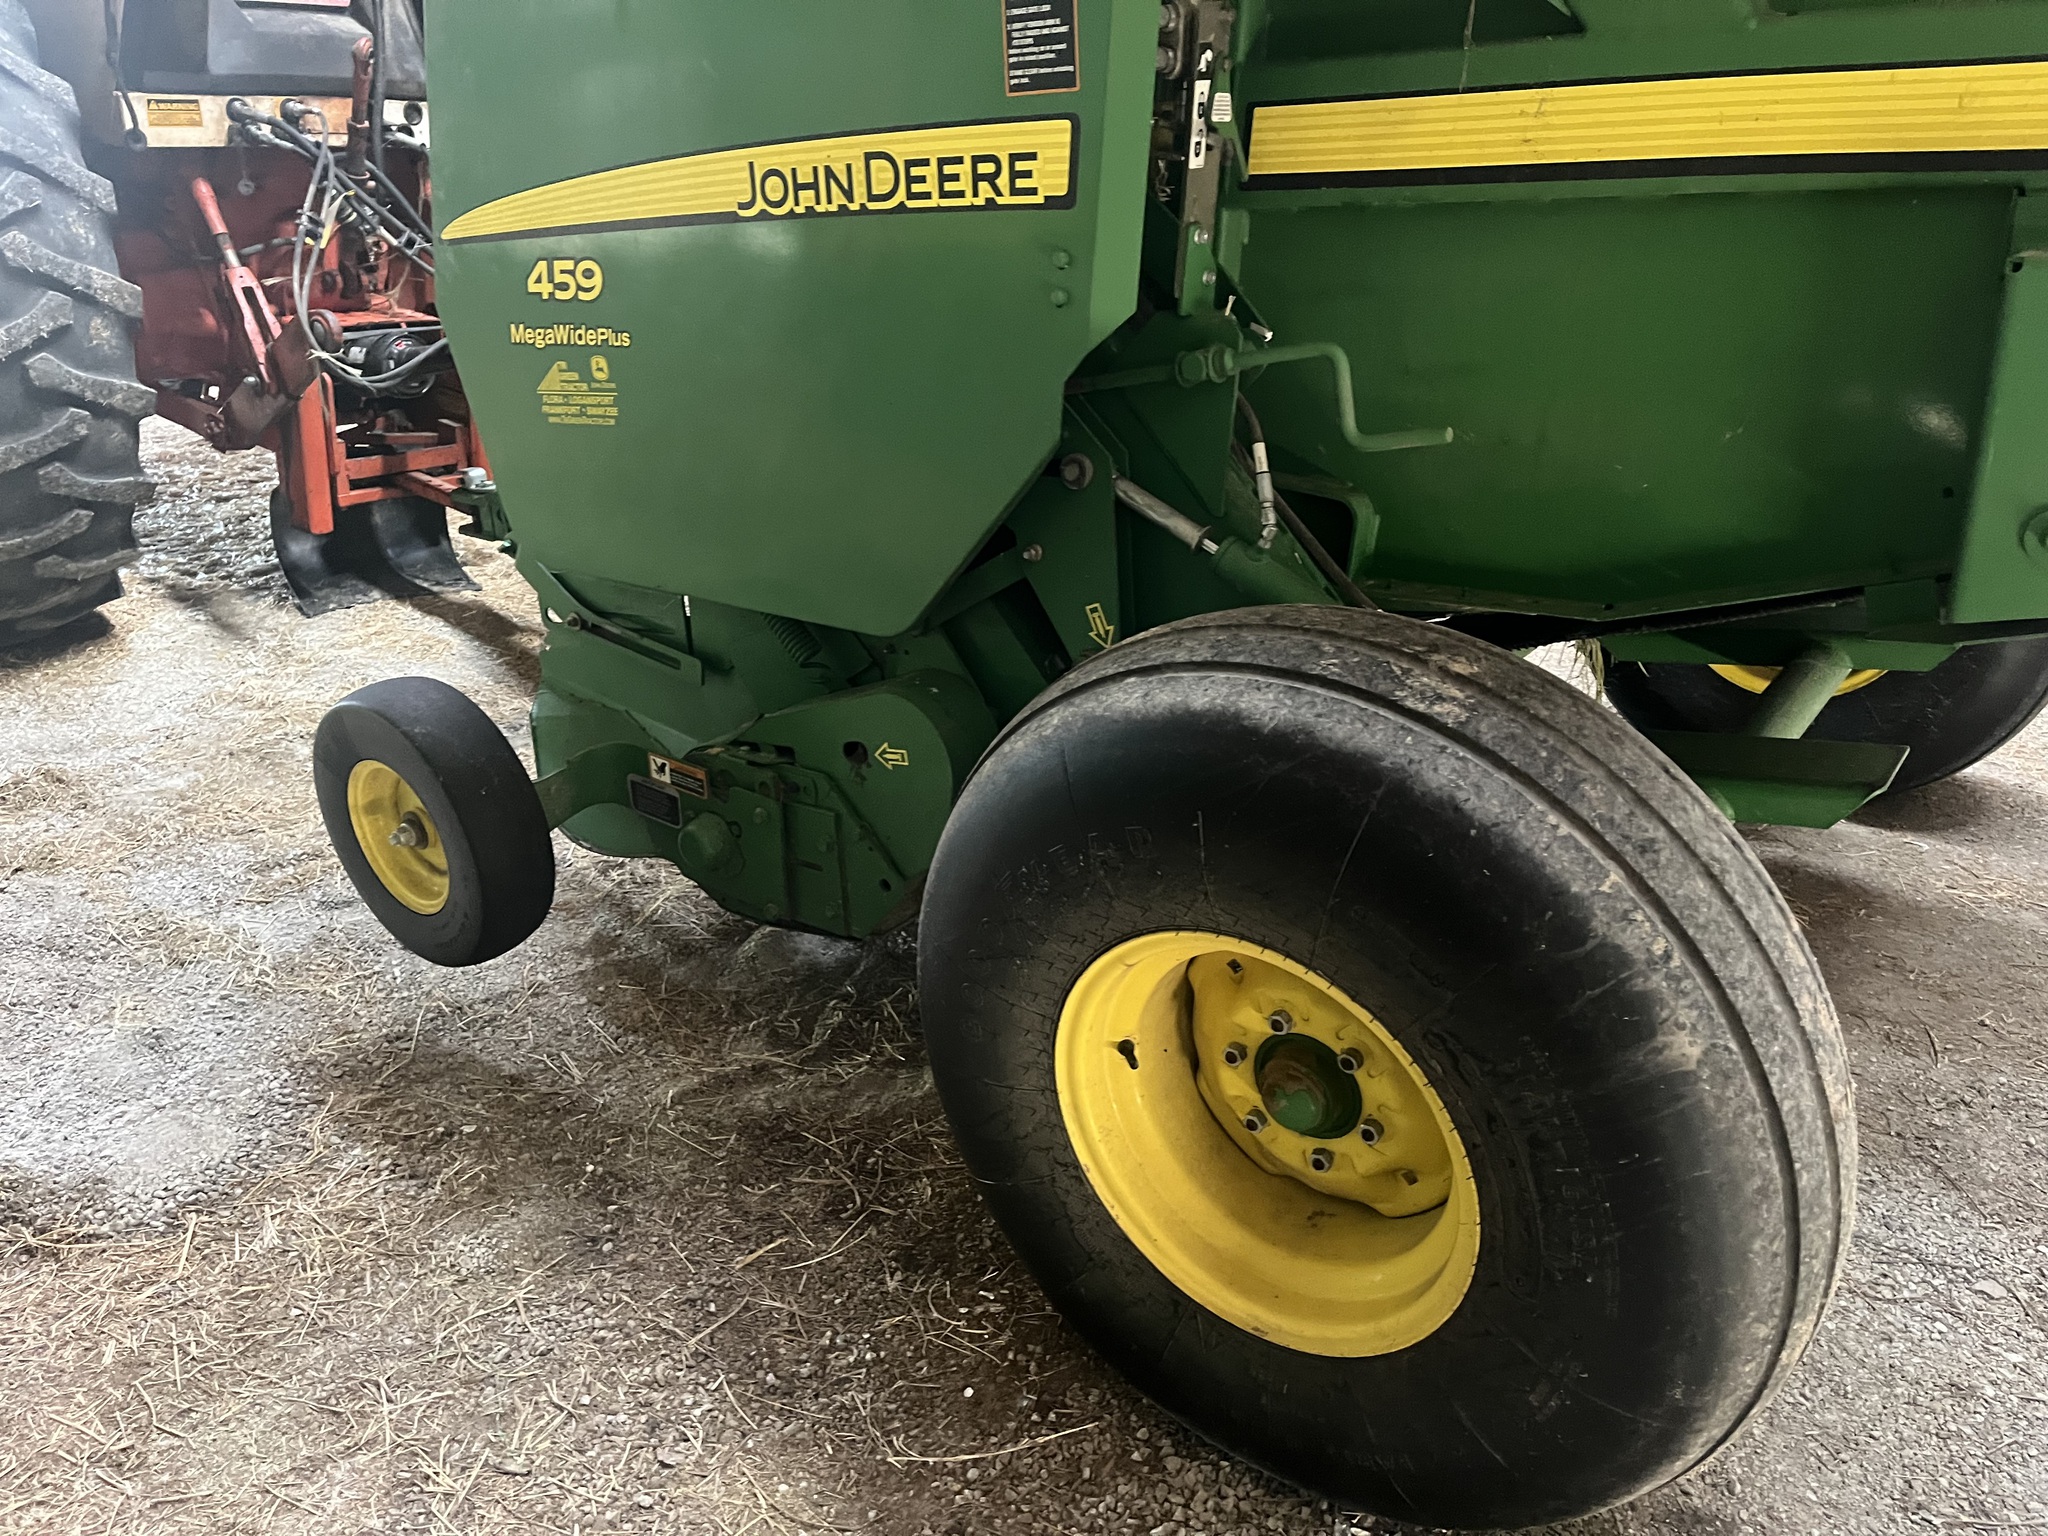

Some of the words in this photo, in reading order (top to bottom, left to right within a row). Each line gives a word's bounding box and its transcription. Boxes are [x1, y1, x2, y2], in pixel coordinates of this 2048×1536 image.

[736, 160, 853, 211] JOHN
[864, 151, 1039, 202] DEERE
[527, 258, 604, 301] 459
[509, 323, 632, 348] MegaWidePlus
